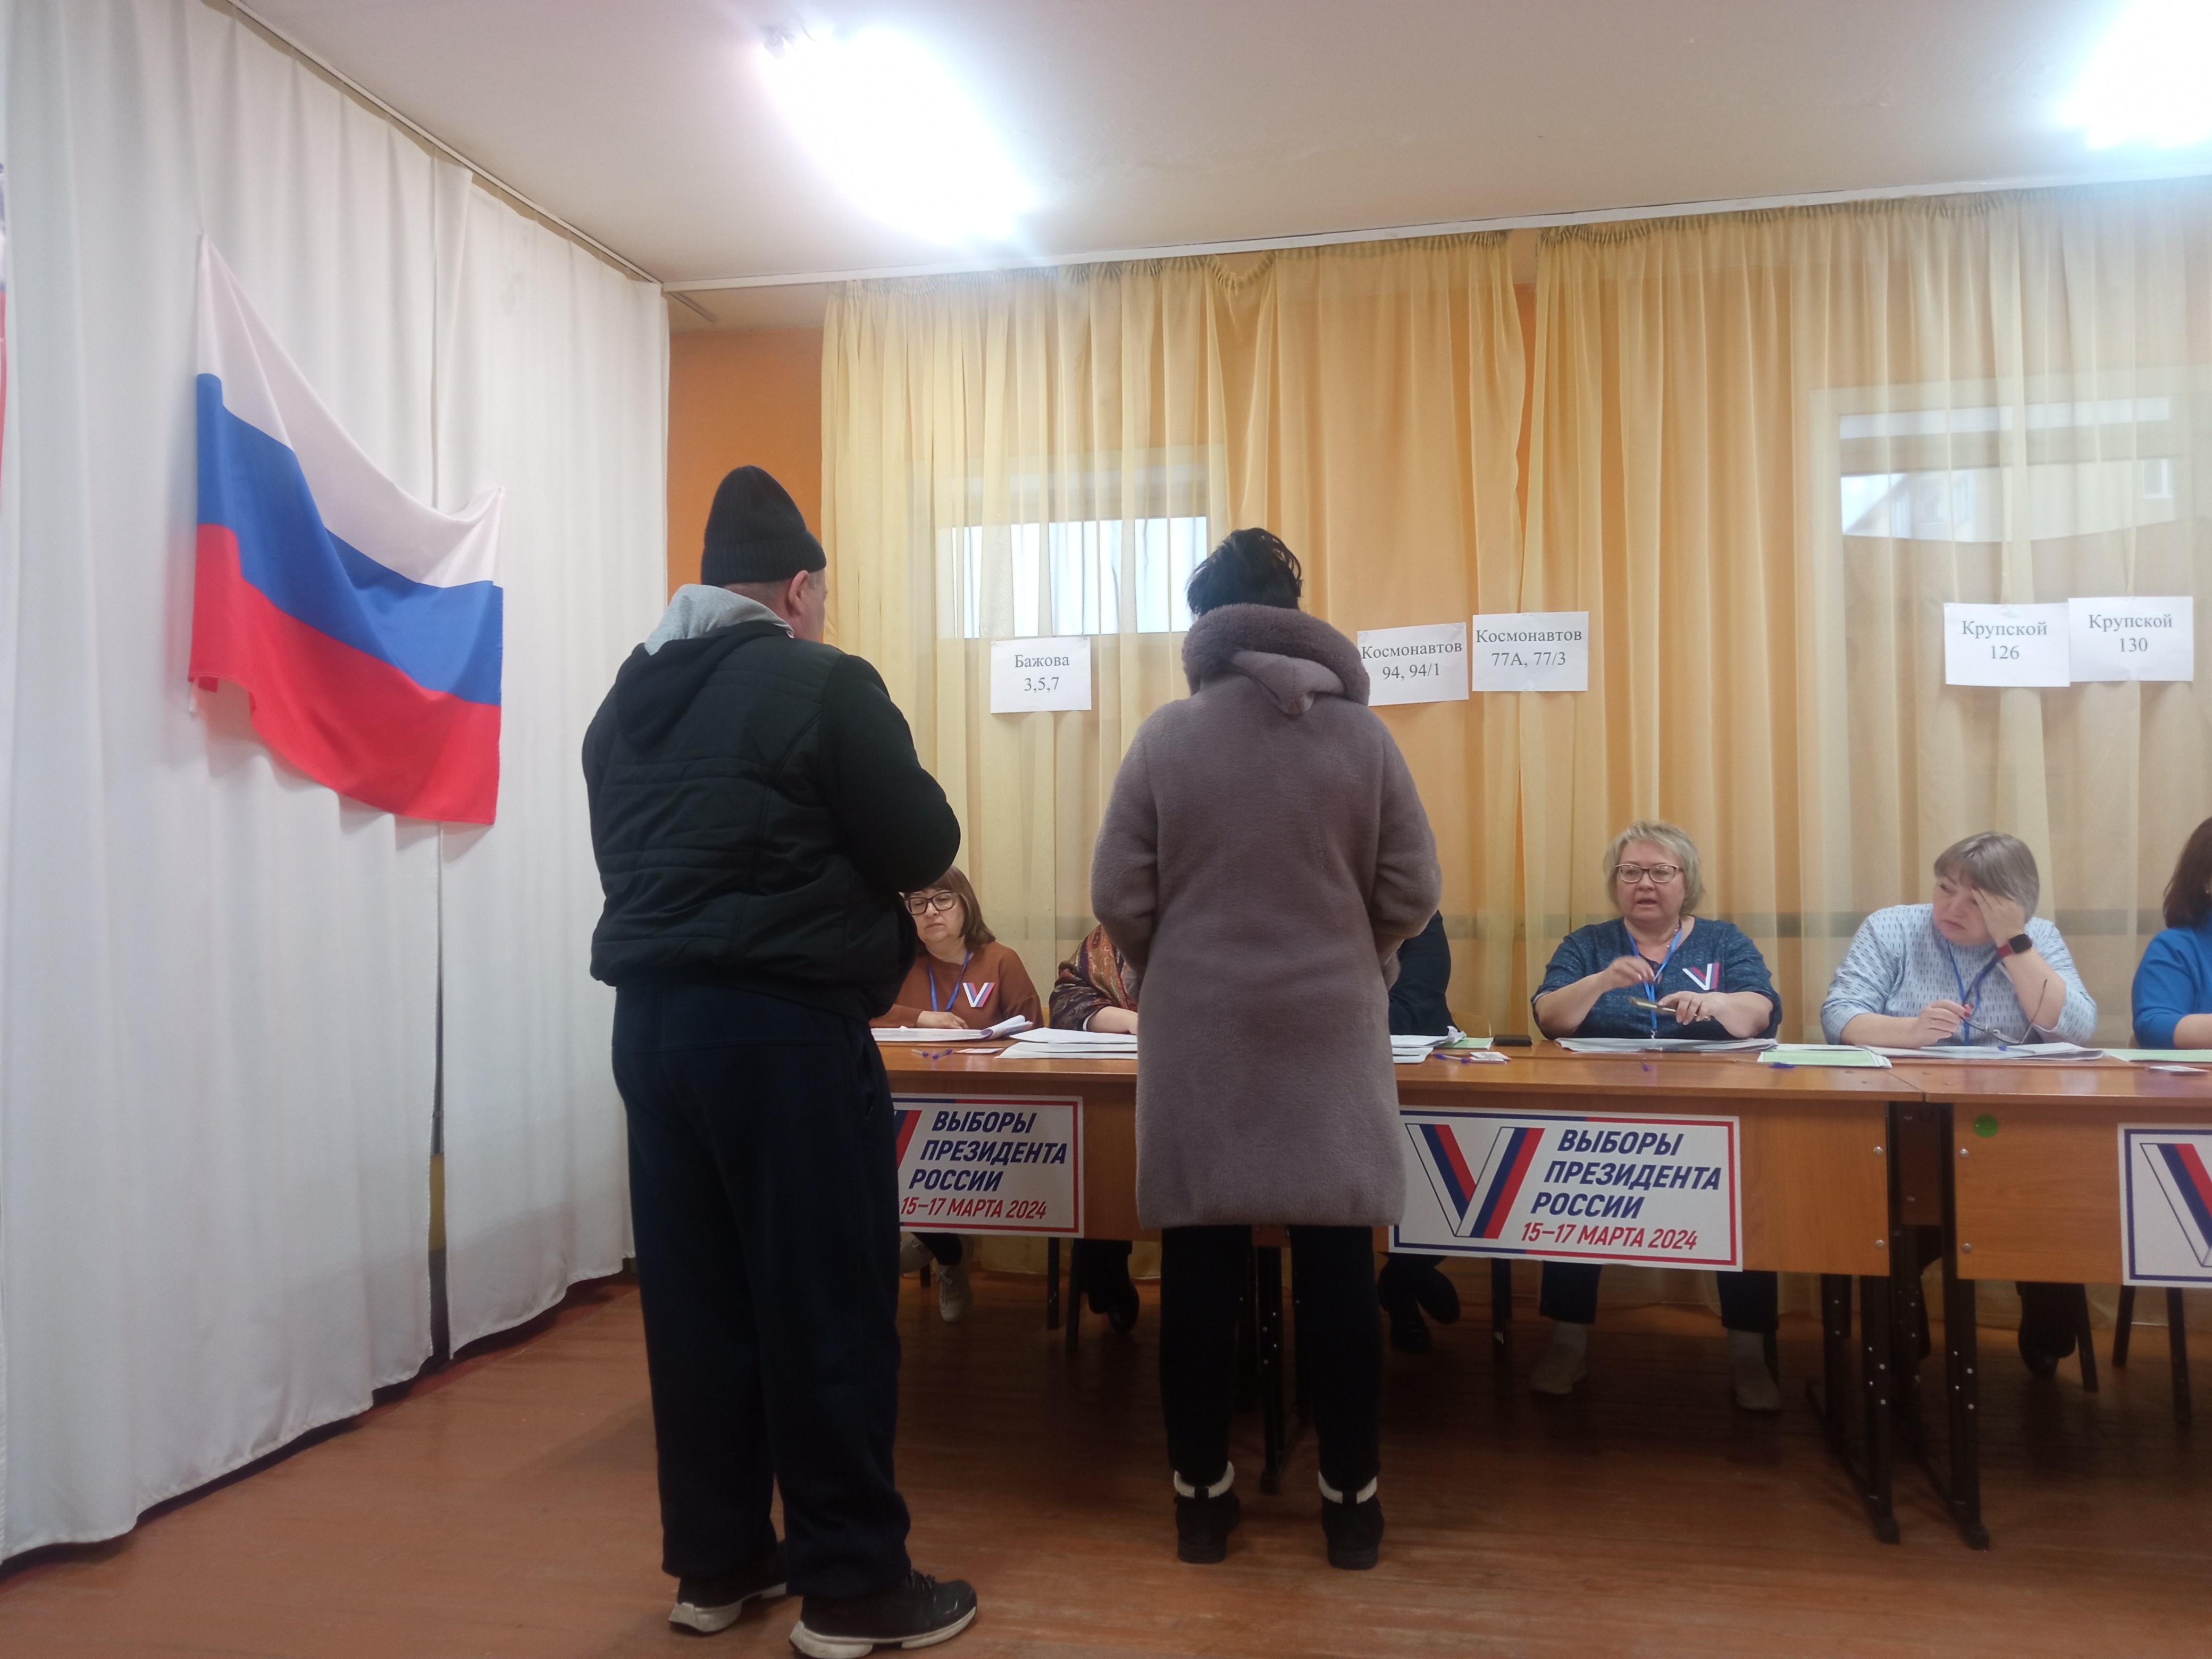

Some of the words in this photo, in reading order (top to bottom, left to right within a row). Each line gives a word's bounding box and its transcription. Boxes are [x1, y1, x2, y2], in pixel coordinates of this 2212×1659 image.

[1962, 621, 2048, 639] Крупской
[2089, 614, 2173, 632] Крупской
[1476, 630, 1582, 643] Космонавтов
[2119, 638, 2148, 652] 130
[1361, 642, 1462, 660] Космонавтов
[1491, 652, 1528, 668] 77А,
[1533, 651, 1566, 666] 77/3
[1990, 645, 2020, 660] 126
[1014, 654, 1070, 668] Бажова
[1382, 666, 1404, 681] 94,
[1409, 663, 1440, 678] 94/1
[1024, 676, 1059, 693] 3,5,7
[932, 1110, 1037, 1134] ВЫБОРЫ
[1557, 1129, 1684, 1156] ВЫБОРЫ
[920, 1139, 1067, 1166] ПРЕЗИДЕНТА
[908, 1168, 1004, 1192] РОССИИ
[1544, 1160, 1722, 1191] ПРЕЗИДЕНТА
[946, 1198, 1004, 1218] МАРТА
[1005, 1200, 1047, 1220] 2024
[1530, 1191, 1645, 1219] РОССИИ
[1577, 1224, 1645, 1247] МАРТА
[1648, 1228, 1698, 1251] 2024
